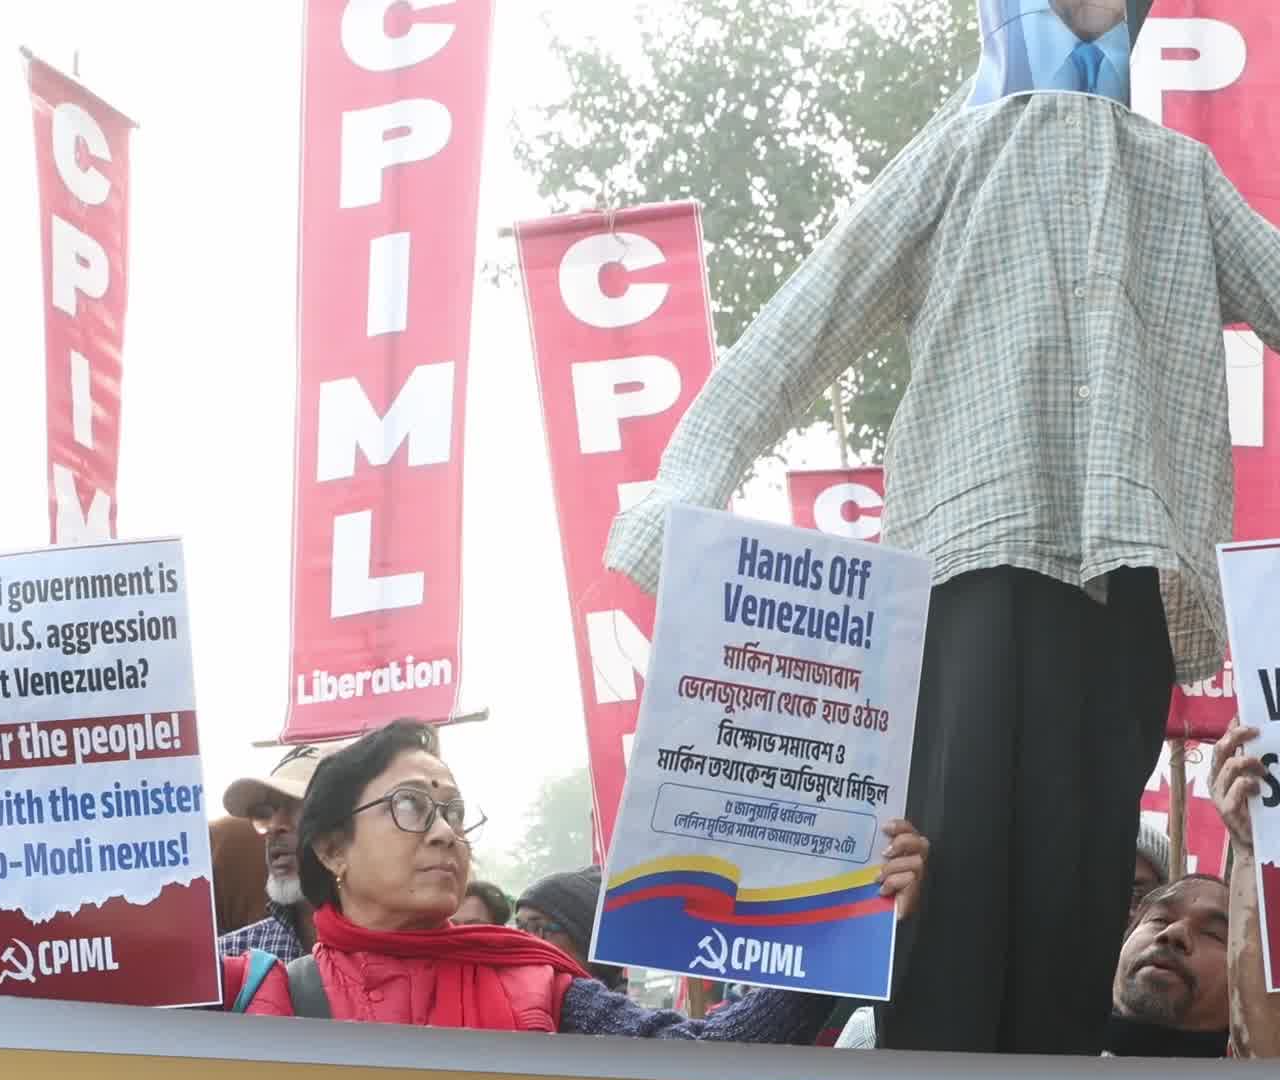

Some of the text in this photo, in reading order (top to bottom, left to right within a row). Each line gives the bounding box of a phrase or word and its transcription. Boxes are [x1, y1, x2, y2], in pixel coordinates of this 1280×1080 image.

[315, 0, 457, 620] CPIML
[7, 566, 154, 613] government
[158, 562, 178, 593] is
[737, 536, 873, 601] Hands Off
[0, 620, 42, 651] U.S.
[46, 610, 177, 655] aggression
[723, 581, 875, 650] Venezuela!
[14, 658, 149, 697] Venezuela?
[296, 655, 453, 706] Liberation
[722, 642, 862, 693] মার্কিন সাম্রাজ্যবাদ
[677, 674, 890, 733] ভেনেজুয়েলা থেকে হাত ওঠাও
[18, 721, 68, 759] the
[72, 712, 182, 764] people!
[716, 718, 846, 764] বিক্ষোভ সমাবেশ ও
[657, 745, 890, 806] মার্কিন তথ্যকেন্দ্র অভিমুখে মিছিল
[48, 786, 97, 823] the
[101, 779, 203, 819] sinister
[673, 811, 707, 829] লেনিন
[733, 799, 780, 823] জানুয়ারি
[100, 831, 190, 871] nexus!
[37, 936, 120, 976] CPIML
[731, 938, 806, 978] CPIML
